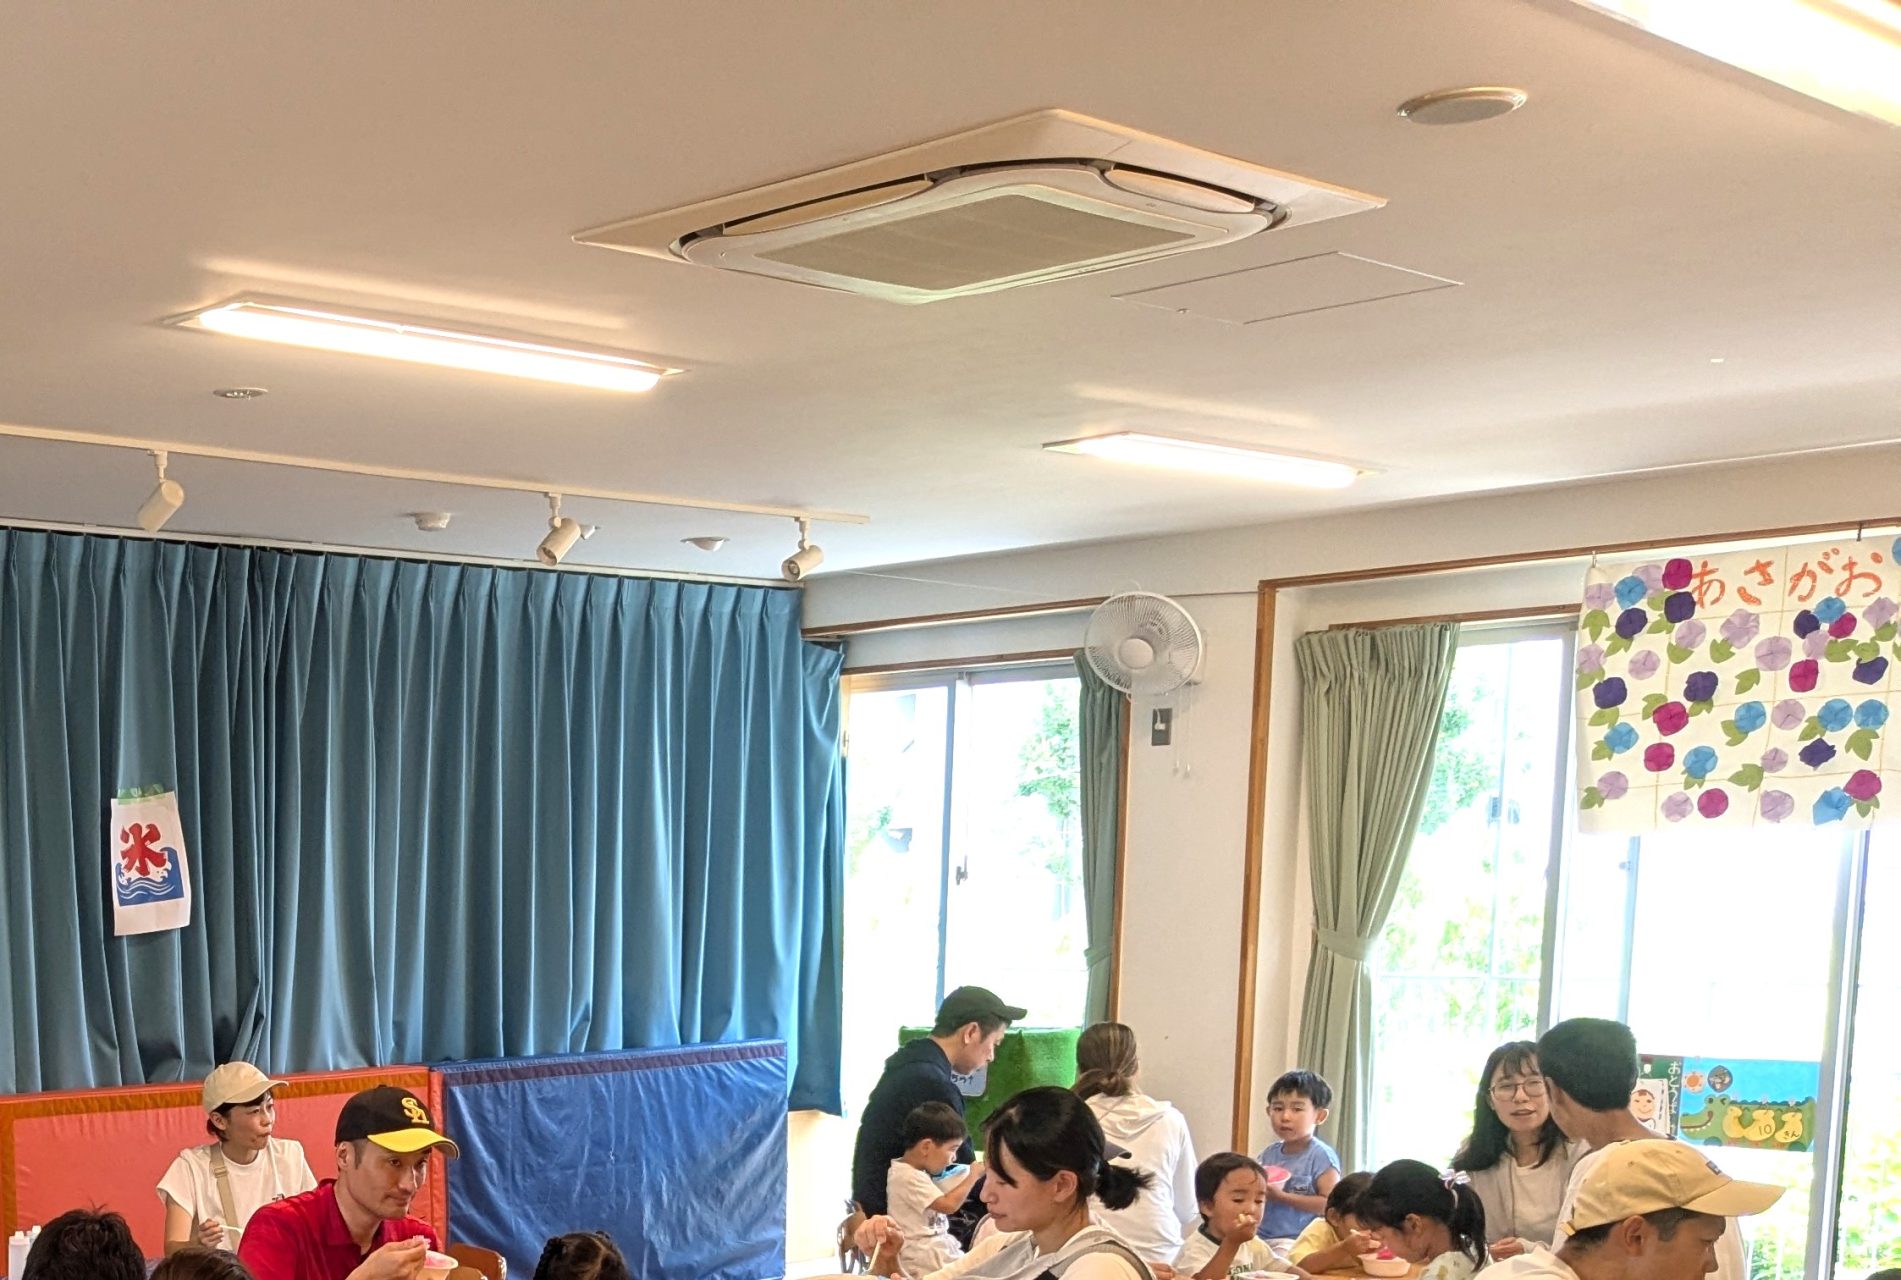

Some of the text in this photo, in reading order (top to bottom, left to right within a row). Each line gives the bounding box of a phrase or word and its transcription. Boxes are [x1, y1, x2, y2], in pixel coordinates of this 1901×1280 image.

[1691, 547, 1883, 609] あさがお
[120, 823, 167, 877] 氷
[1759, 1124, 1772, 1136] 10
